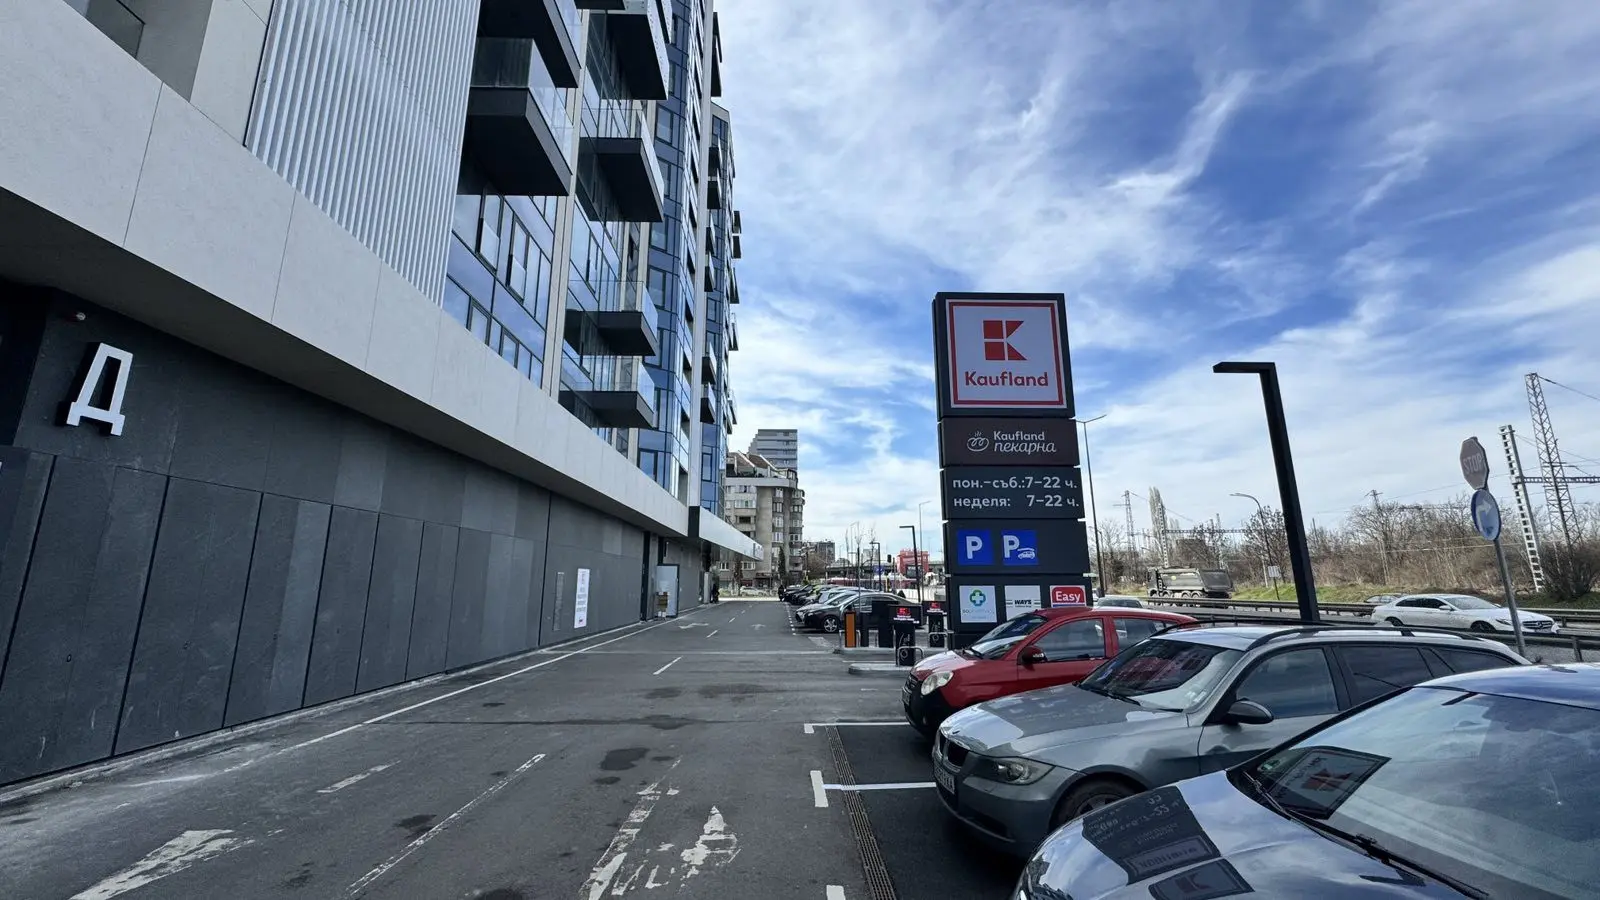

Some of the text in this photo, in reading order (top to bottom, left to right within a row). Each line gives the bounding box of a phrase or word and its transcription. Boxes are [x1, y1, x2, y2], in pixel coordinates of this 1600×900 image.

[964, 371, 1049, 387] Kaufland
[66, 342, 134, 436] Д
[993, 431, 1045, 441] Kaufland
[993, 442, 1057, 455] пекарна
[1462, 453, 1483, 475] STOP
[1064, 480, 1077, 489] ч.
[953, 497, 1011, 509] неделя:
[1066, 499, 1080, 507] ч.
[966, 535, 1020, 560] P P
[1055, 591, 1081, 603] Easy
